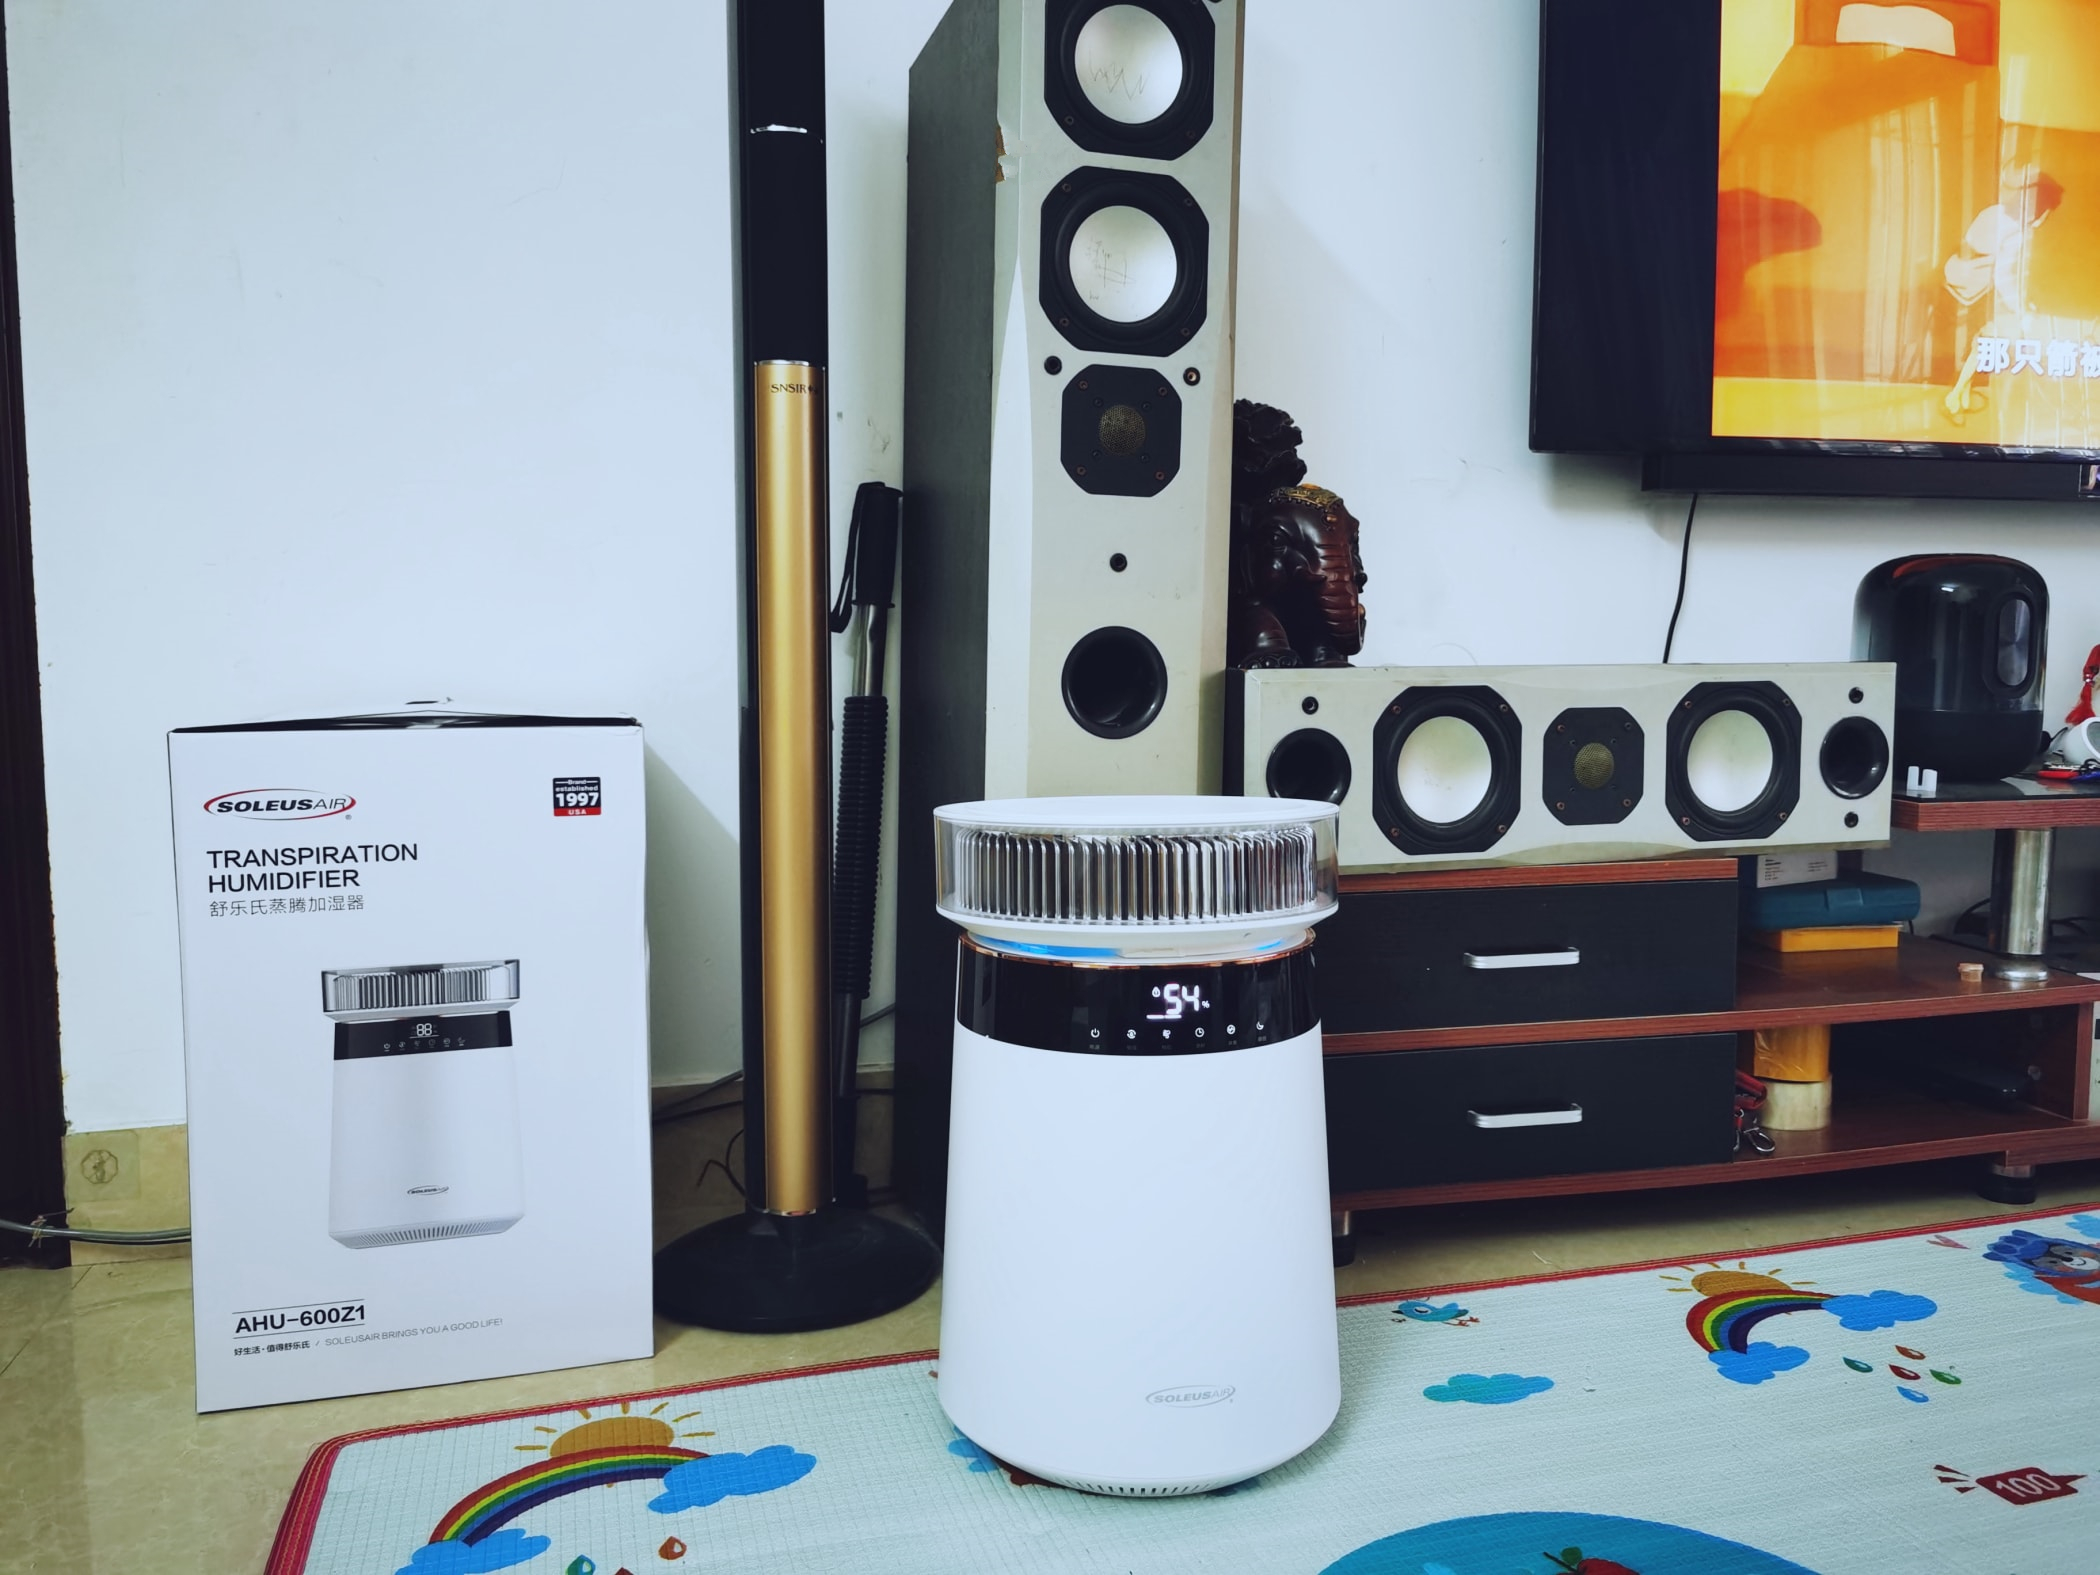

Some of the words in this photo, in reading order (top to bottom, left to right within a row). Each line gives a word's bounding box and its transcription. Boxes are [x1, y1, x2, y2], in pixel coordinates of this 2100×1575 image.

[216, 798, 346, 813] SOLEUSAIR
[555, 792, 599, 807] 1997
[206, 843, 418, 868] TRANSPIRATION
[209, 869, 360, 893] HUMIDIFIER
[209, 895, 365, 917] 舒乐氏蒸腾加湿器
[235, 1305, 365, 1333] AHU-600Z1
[325, 1333, 380, 1346] SOLEUSAIR
[381, 1328, 418, 1340] BRINGS
[420, 1325, 441, 1335] YOU
[441, 1324, 449, 1332] A
[450, 1321, 479, 1331] GOOD
[480, 1318, 503, 1328] LIFE!
[1995, 1473, 2061, 1498] 100
